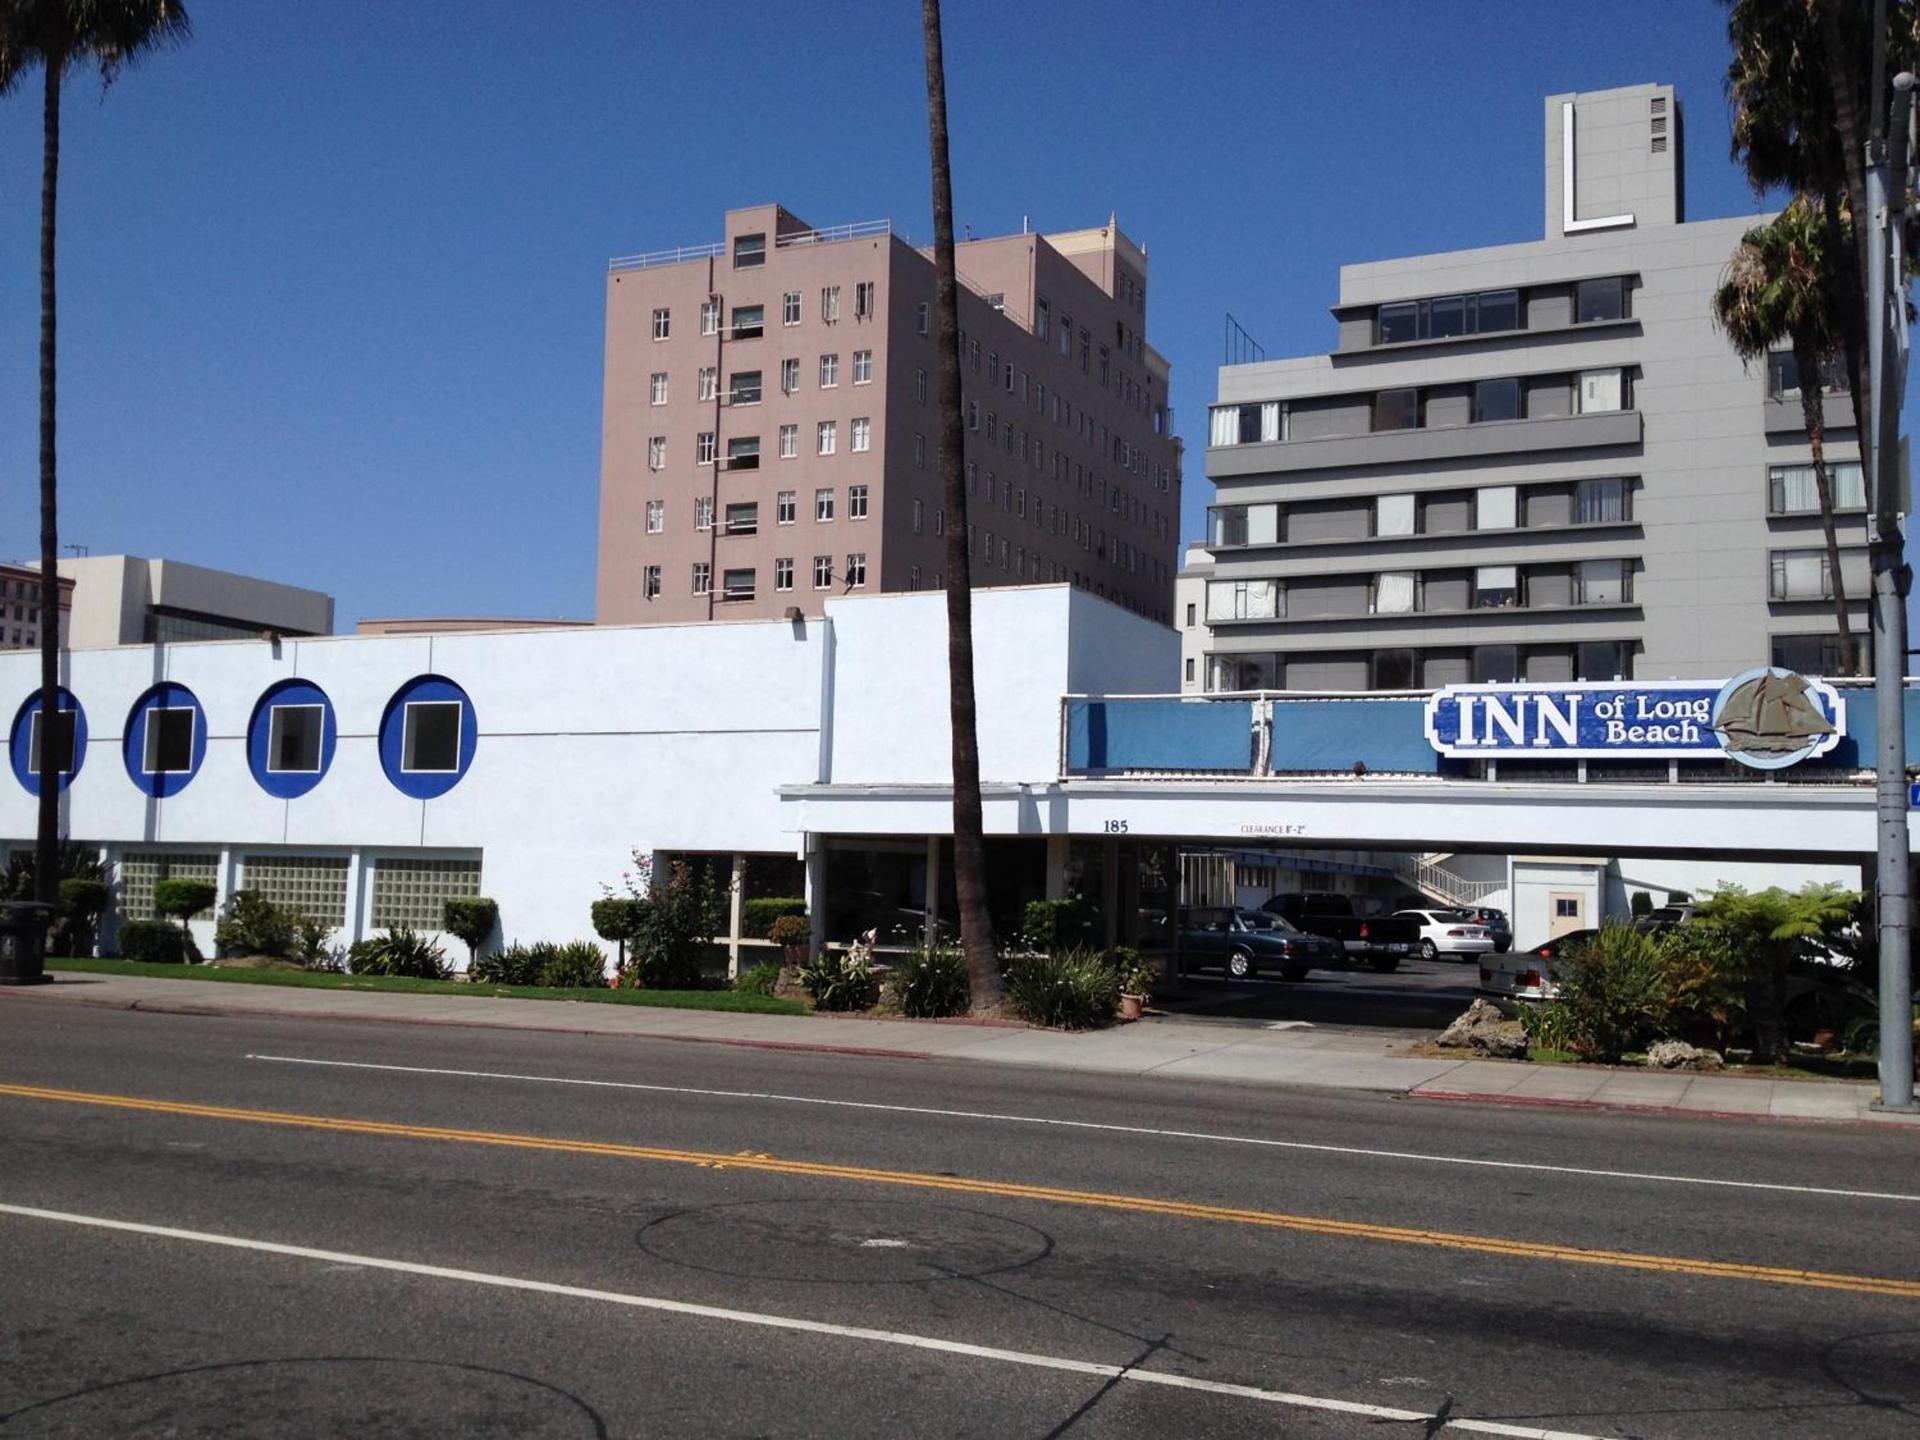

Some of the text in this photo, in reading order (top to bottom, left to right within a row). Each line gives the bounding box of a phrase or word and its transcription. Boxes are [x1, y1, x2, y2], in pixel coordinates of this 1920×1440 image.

[1595, 695, 1710, 722] of Long
[1455, 695, 1582, 746] INN
[1606, 720, 1701, 743] Beach
[1103, 819, 1128, 834] 185
[1240, 824, 1283, 834] CLEARANCE
